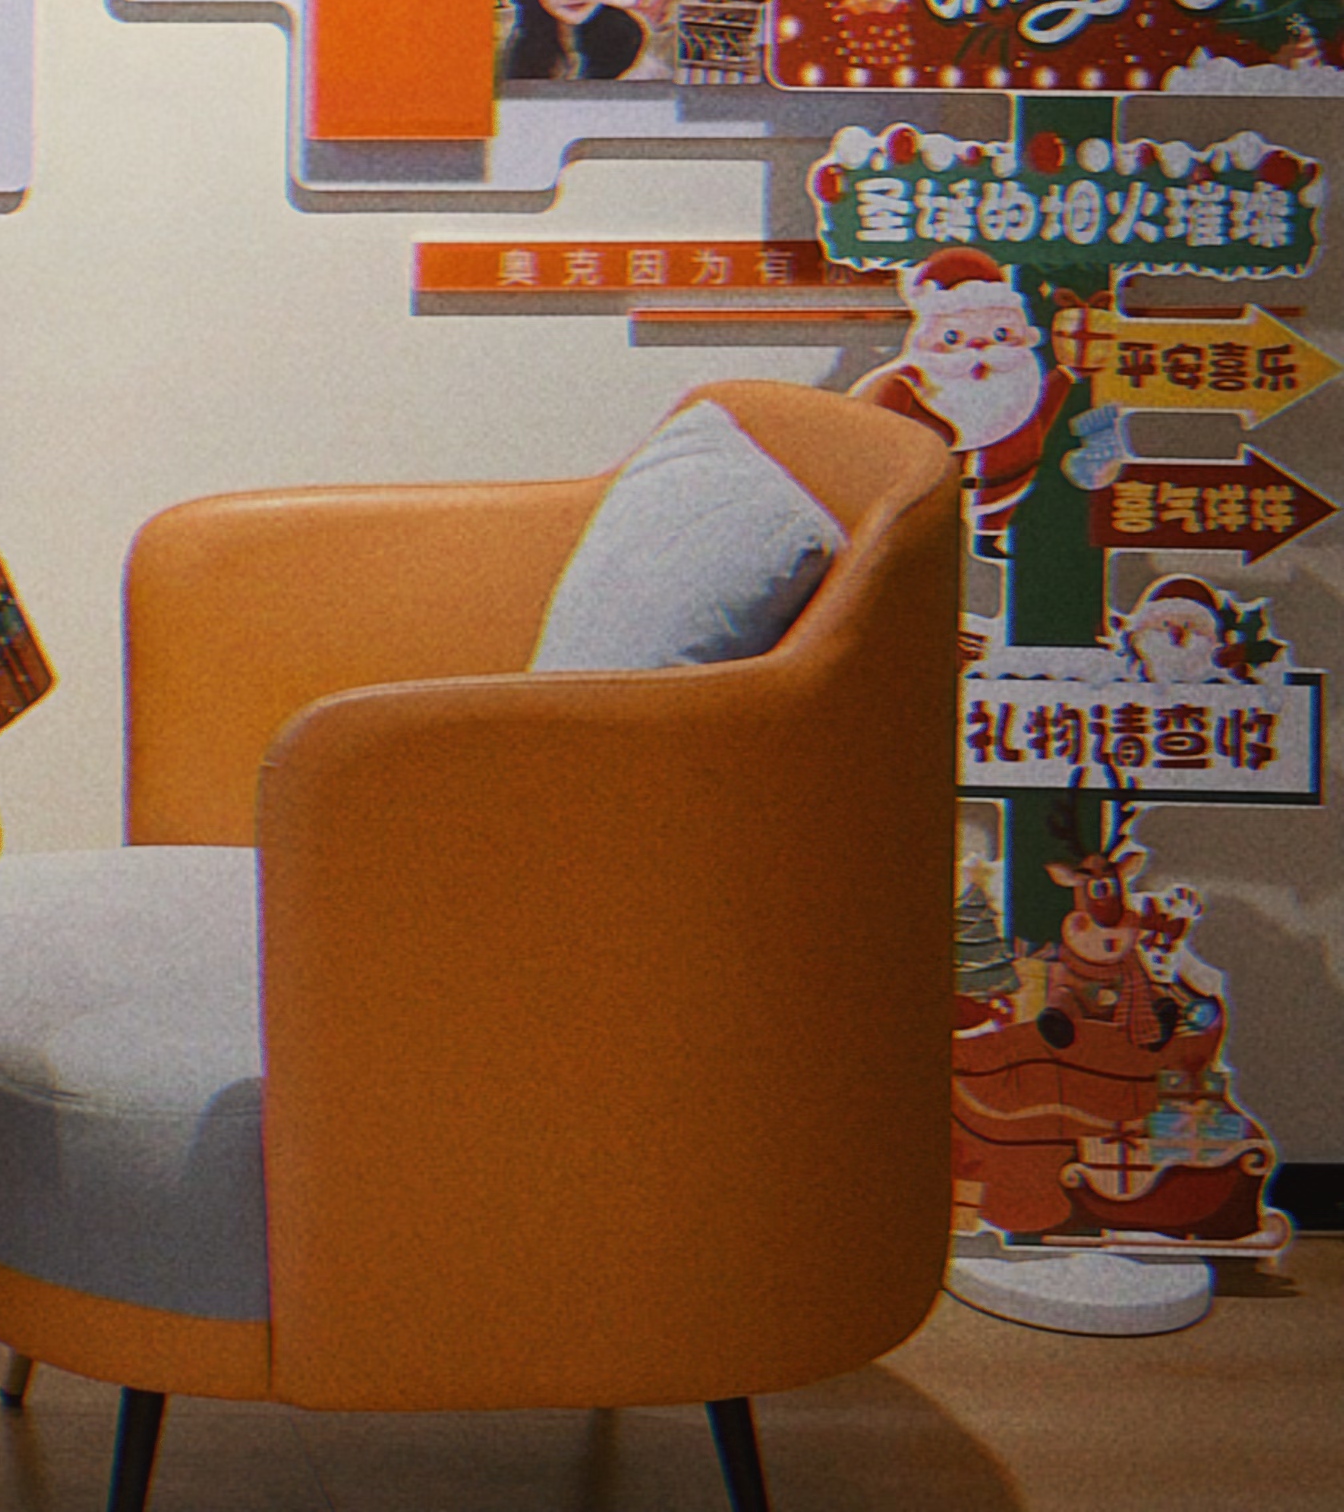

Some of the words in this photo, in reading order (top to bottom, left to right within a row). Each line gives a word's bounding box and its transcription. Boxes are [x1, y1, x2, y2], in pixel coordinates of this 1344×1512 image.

[853, 176, 1299, 248] 圣诞的烟火璀璨
[1115, 341, 1301, 392] 平安喜乐
[1112, 479, 1296, 534] 喜气洋洋
[965, 699, 1281, 771] 礼物请查收
